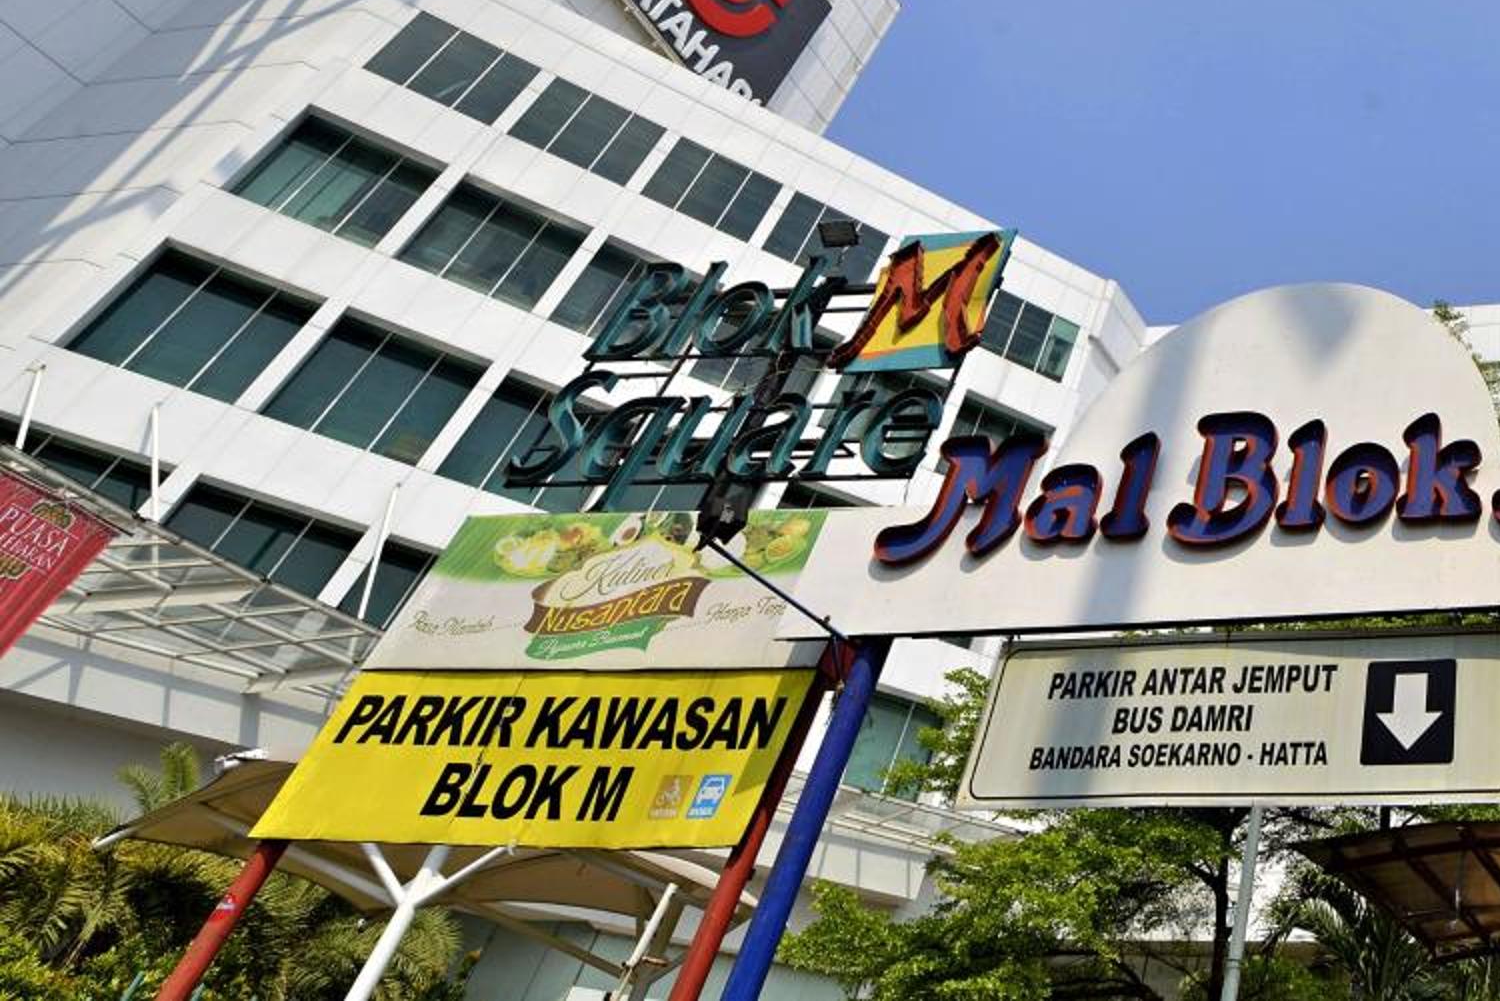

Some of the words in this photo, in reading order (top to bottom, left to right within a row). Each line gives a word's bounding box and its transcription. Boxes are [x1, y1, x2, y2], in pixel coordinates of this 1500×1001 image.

[583, 253, 848, 360] Blok
[828, 232, 1002, 370] M
[505, 370, 946, 513] Square
[874, 430, 1162, 568] Mal
[1165, 410, 1484, 547] Blok
[539, 580, 693, 635] Nusantara
[1048, 668, 1138, 700] PARKIR
[1142, 666, 1226, 696] ANTAR
[1232, 664, 1339, 694] JEMPUT
[333, 695, 528, 749] PARKIR
[524, 696, 788, 751] KAWASAN
[1112, 707, 1164, 734] BUS
[1171, 704, 1254, 732] DAMRI
[1029, 744, 1122, 770] BANDARA
[1127, 742, 1241, 768] SOEKARNO
[1259, 741, 1328, 766] HATTA
[420, 762, 581, 821] BLOK
[576, 766, 636, 822] M
